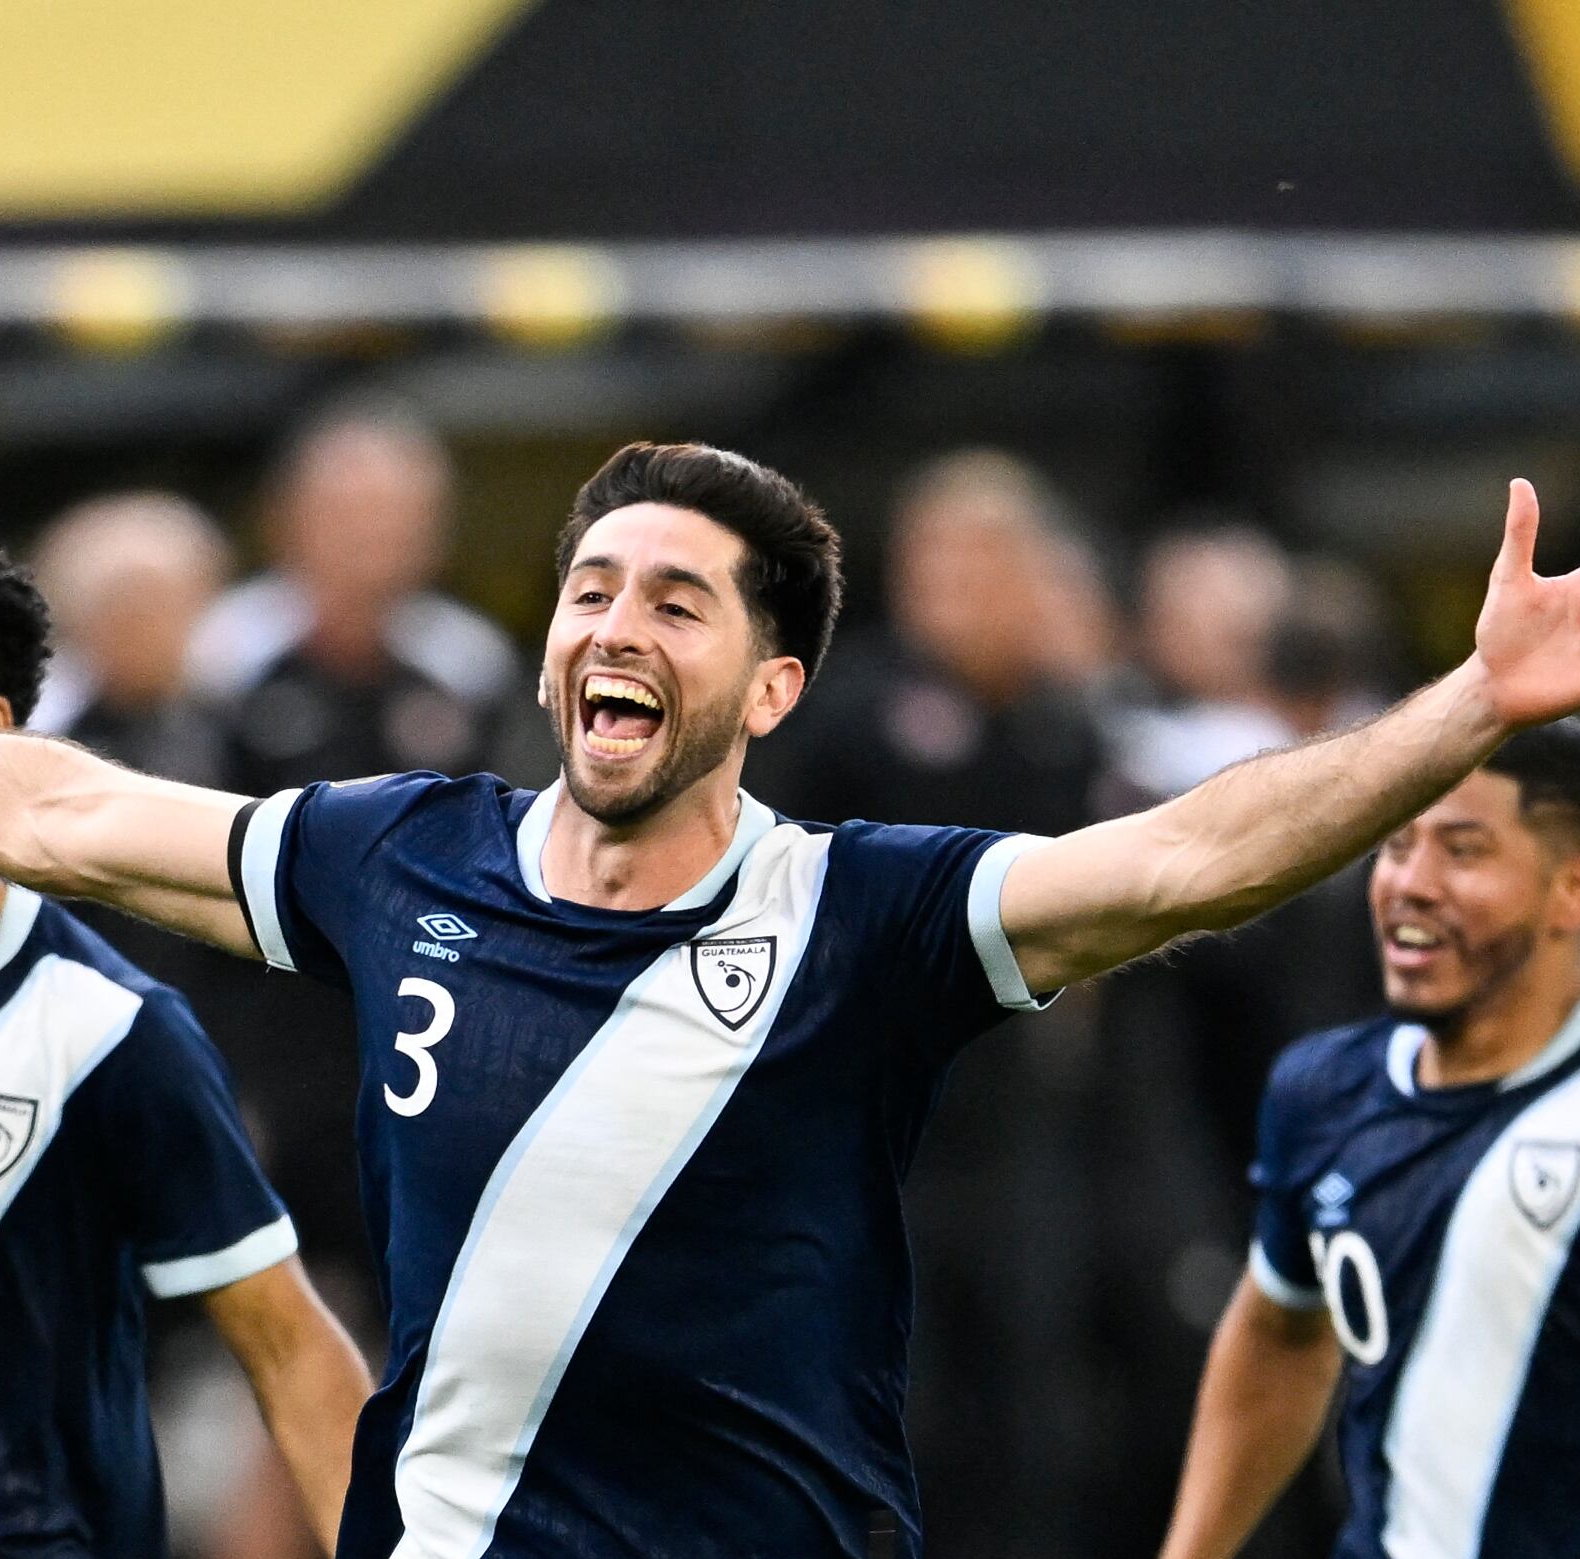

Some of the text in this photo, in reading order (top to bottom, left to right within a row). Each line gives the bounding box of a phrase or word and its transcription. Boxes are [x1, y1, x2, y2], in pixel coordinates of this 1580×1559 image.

[412, 940, 460, 962] umbro
[701, 946, 766, 957] GUATEMALA
[383, 977, 456, 1117] 3
